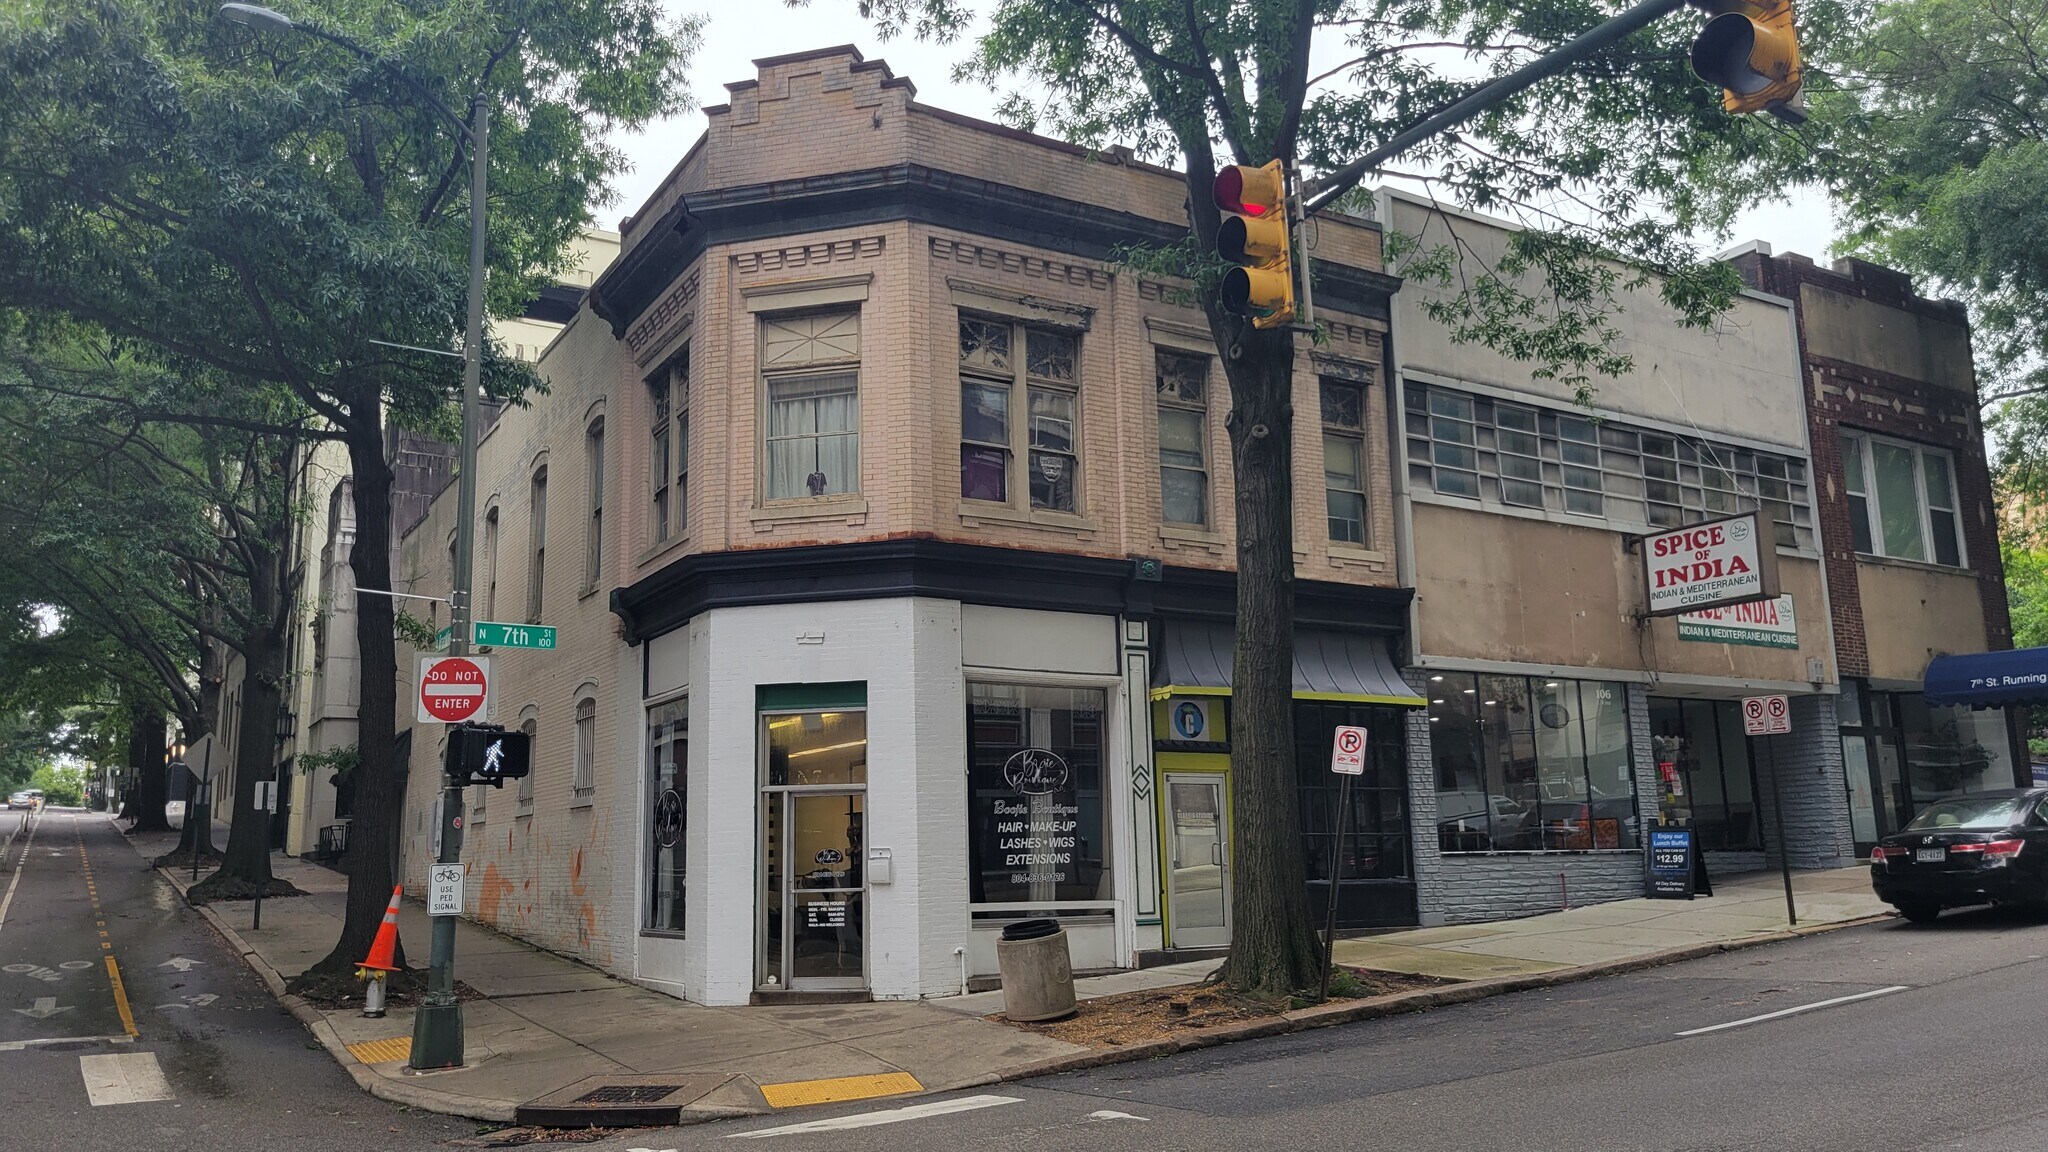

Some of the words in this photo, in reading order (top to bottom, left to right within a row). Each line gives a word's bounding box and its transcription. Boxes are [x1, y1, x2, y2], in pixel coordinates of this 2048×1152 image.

[1654, 526, 1725, 557] SPICE
[1695, 549, 1710, 560] OF
[1654, 555, 1750, 588] INDIA
[1651, 588, 1678, 600] INDIAN
[1680, 587, 1685, 595] &
[1686, 574, 1758, 594] MEDITERRANEAN
[1680, 591, 1722, 604] CUISINE
[1735, 599, 1779, 626] INDIA
[479, 628, 487, 640] N
[502, 626, 529, 645] 7th
[544, 629, 551, 638] St
[1679, 625, 1704, 636] INDIAN
[1704, 628, 1710, 636] &
[1711, 628, 1771, 642] MEDITERRANEAN
[1771, 633, 1798, 644] CUISINE
[538, 638, 551, 647] 100
[432, 671, 447, 681] DO
[455, 671, 479, 681] NOT
[1970, 678, 1984, 689] 7th
[1986, 677, 2000, 687] St.
[2002, 674, 2047, 685] Running
[1596, 689, 1611, 699] 106
[435, 698, 470, 709] ENTER
[1185, 713, 1195, 734] C
[994, 800, 1028, 817] Boojie
[1032, 799, 1079, 817] Boutique
[998, 821, 1023, 833] HAIR
[1029, 821, 1077, 832] MAKE-UP
[1000, 838, 1042, 849] LASHES
[1048, 837, 1075, 848] WIGS
[1006, 852, 1071, 866] EXTENSIONS
[1656, 854, 1684, 863] $12.99
[440, 885, 453, 893] USE
[440, 894, 453, 902] PED
